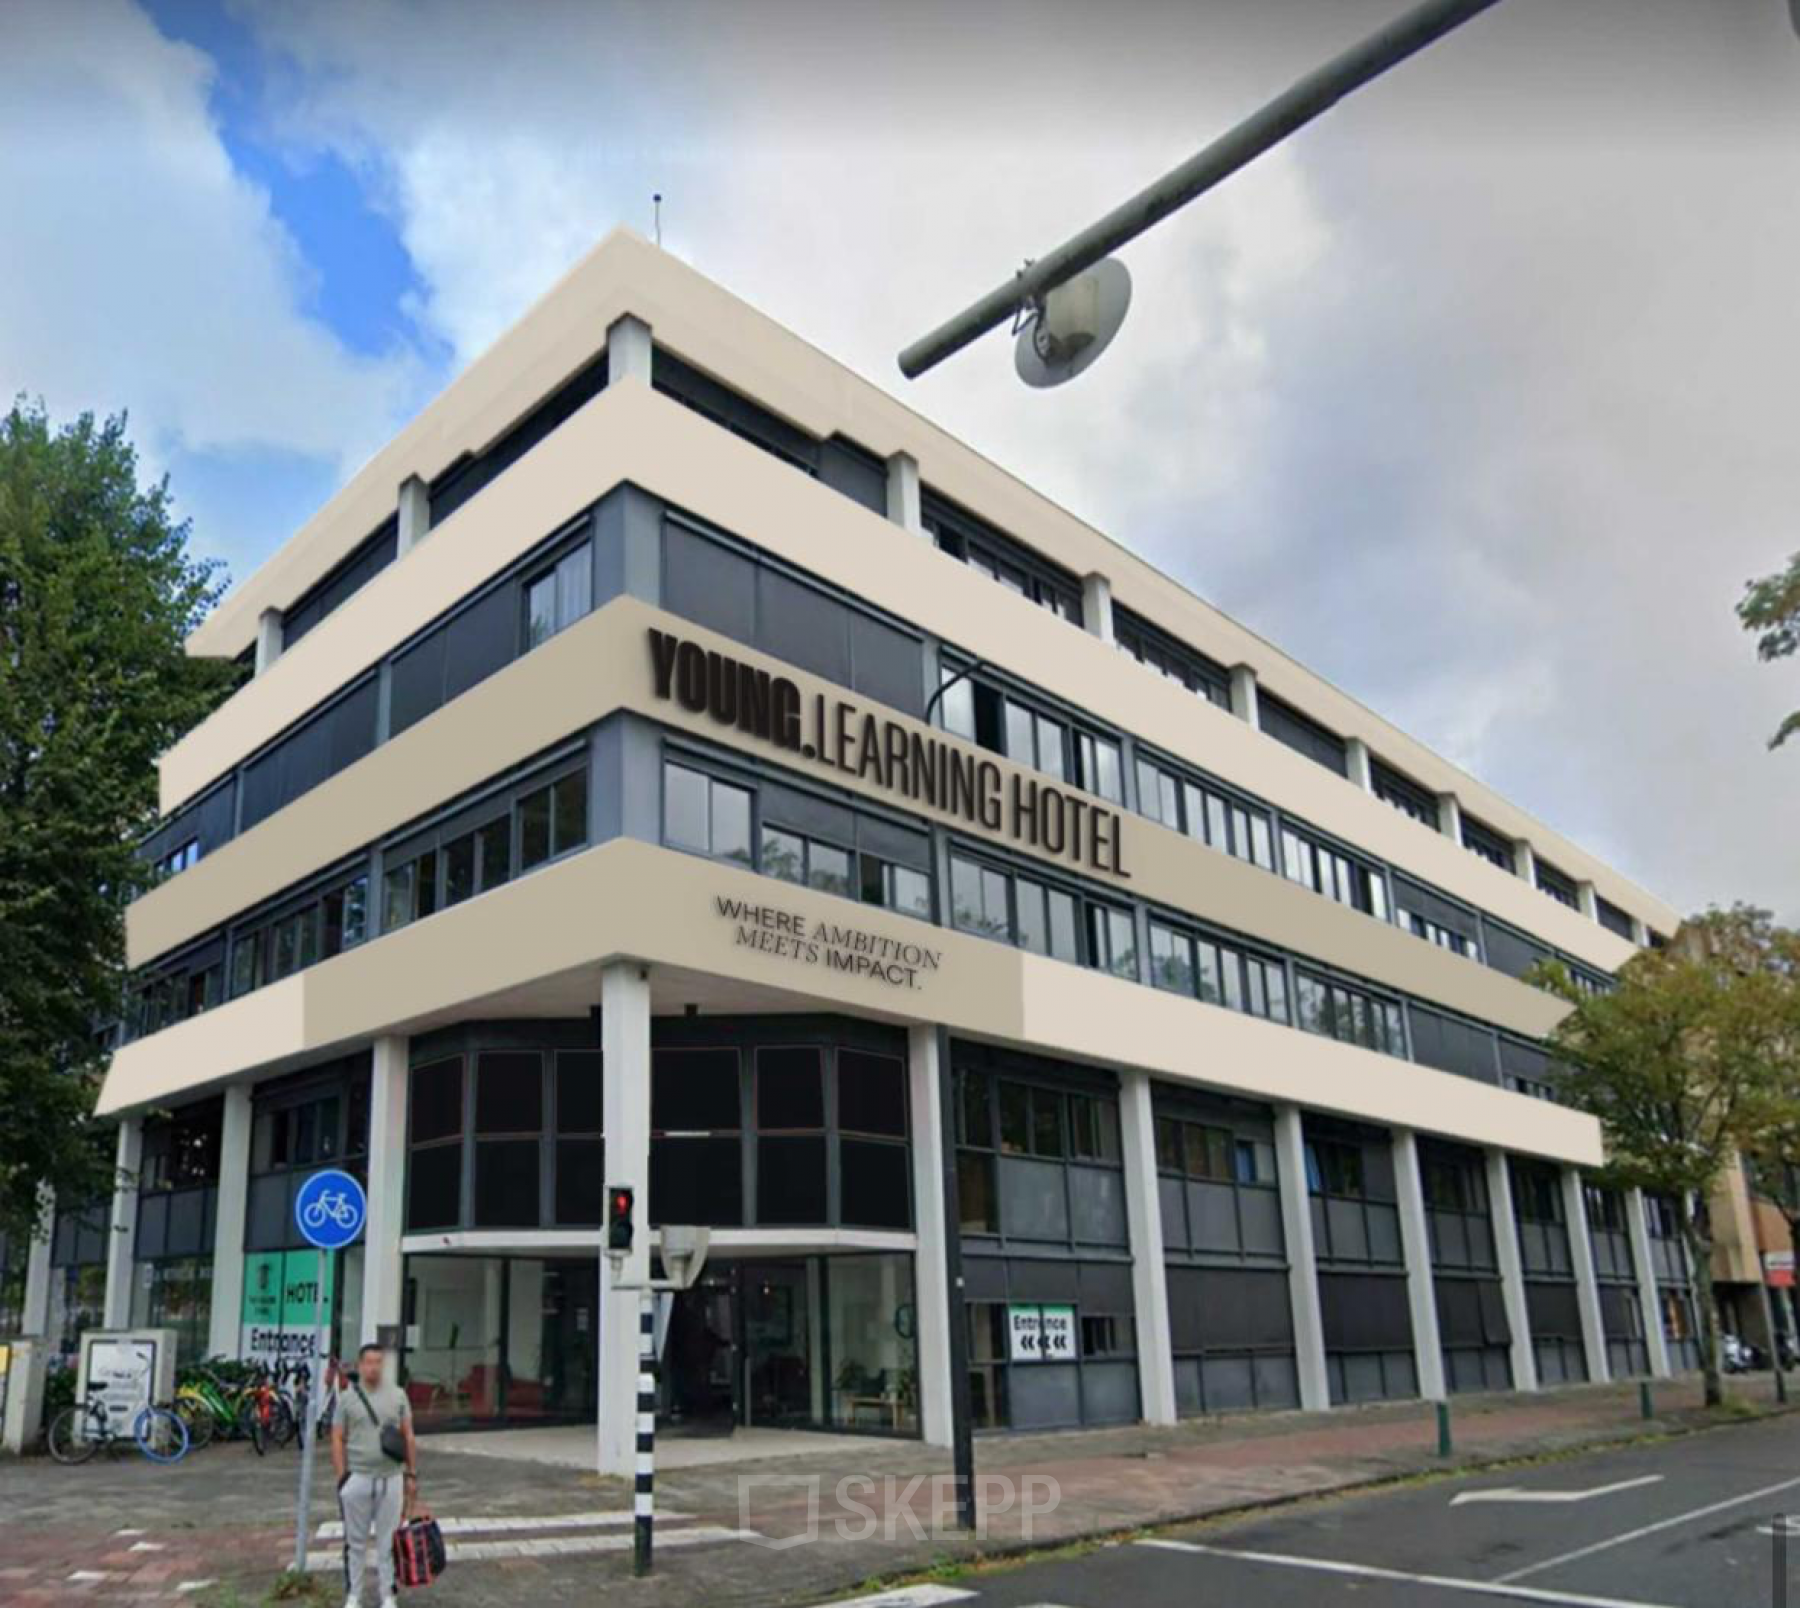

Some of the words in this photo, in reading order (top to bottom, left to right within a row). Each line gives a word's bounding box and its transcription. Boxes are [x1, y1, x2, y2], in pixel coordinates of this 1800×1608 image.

[1012, 772, 1132, 878] HOTEL
[716, 895, 806, 937] WHERE
[812, 921, 942, 971] AMBITION
[735, 925, 819, 964] MEETS
[826, 949, 923, 990] IMPACT.
[1013, 1314, 1067, 1331] Entrnce
